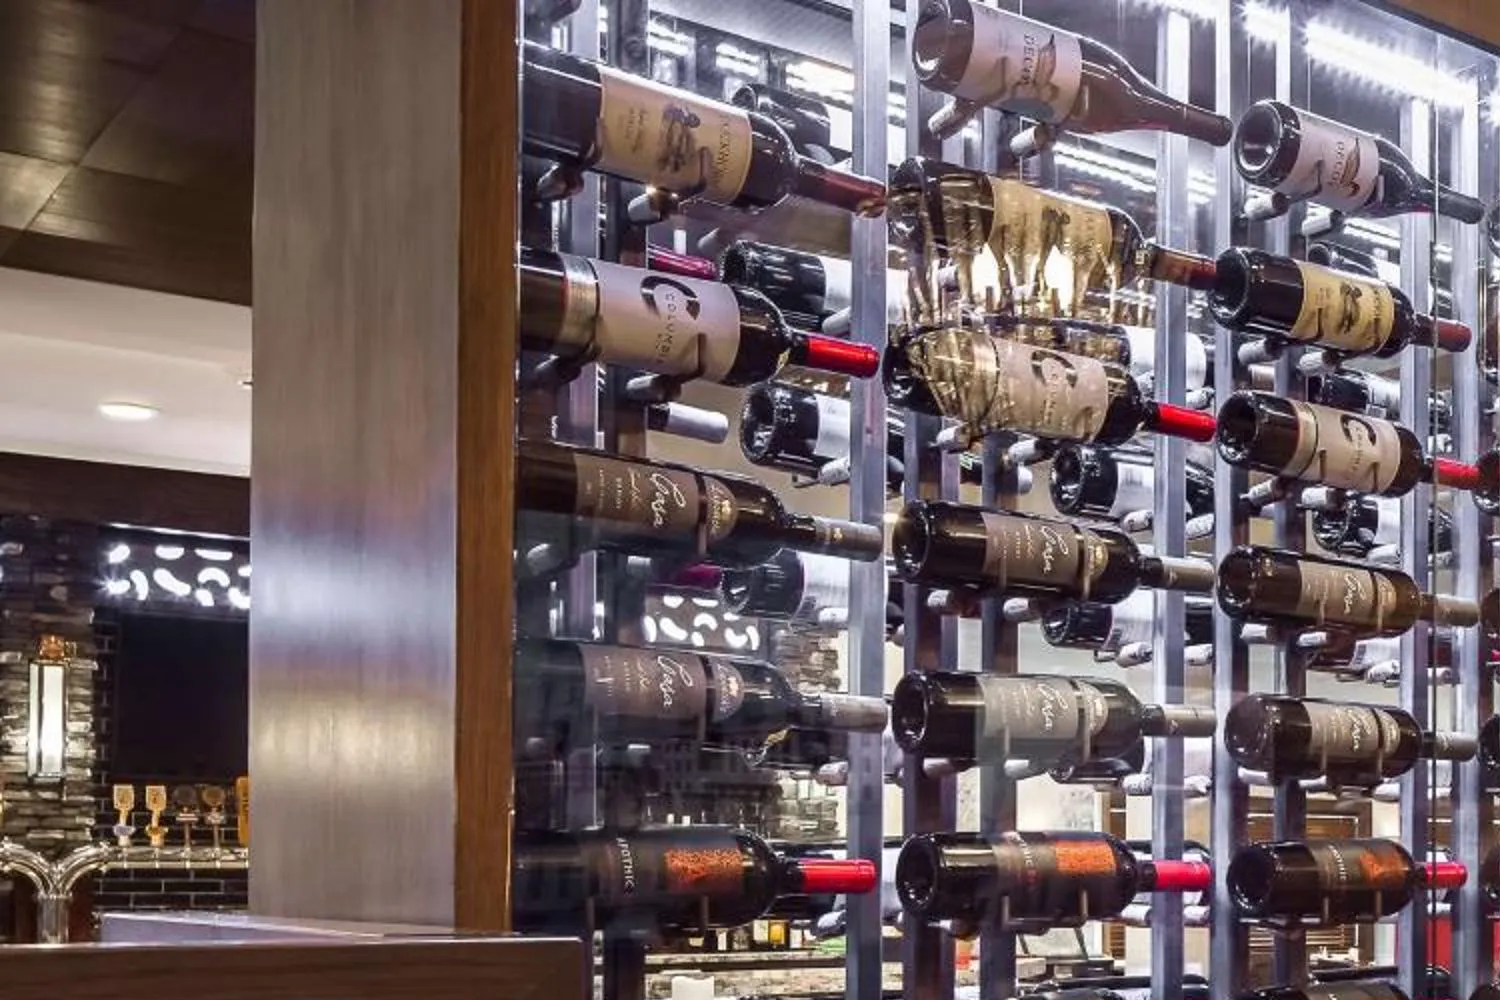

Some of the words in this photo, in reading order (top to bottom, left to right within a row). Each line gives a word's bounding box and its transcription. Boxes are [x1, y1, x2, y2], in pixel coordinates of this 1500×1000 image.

[651, 473, 687, 529] Casa
[1042, 525, 1069, 574] Casa
[657, 655, 693, 709] Casa
[1038, 684, 1068, 734] Casa
[616, 836, 636, 888] APOTHIC
